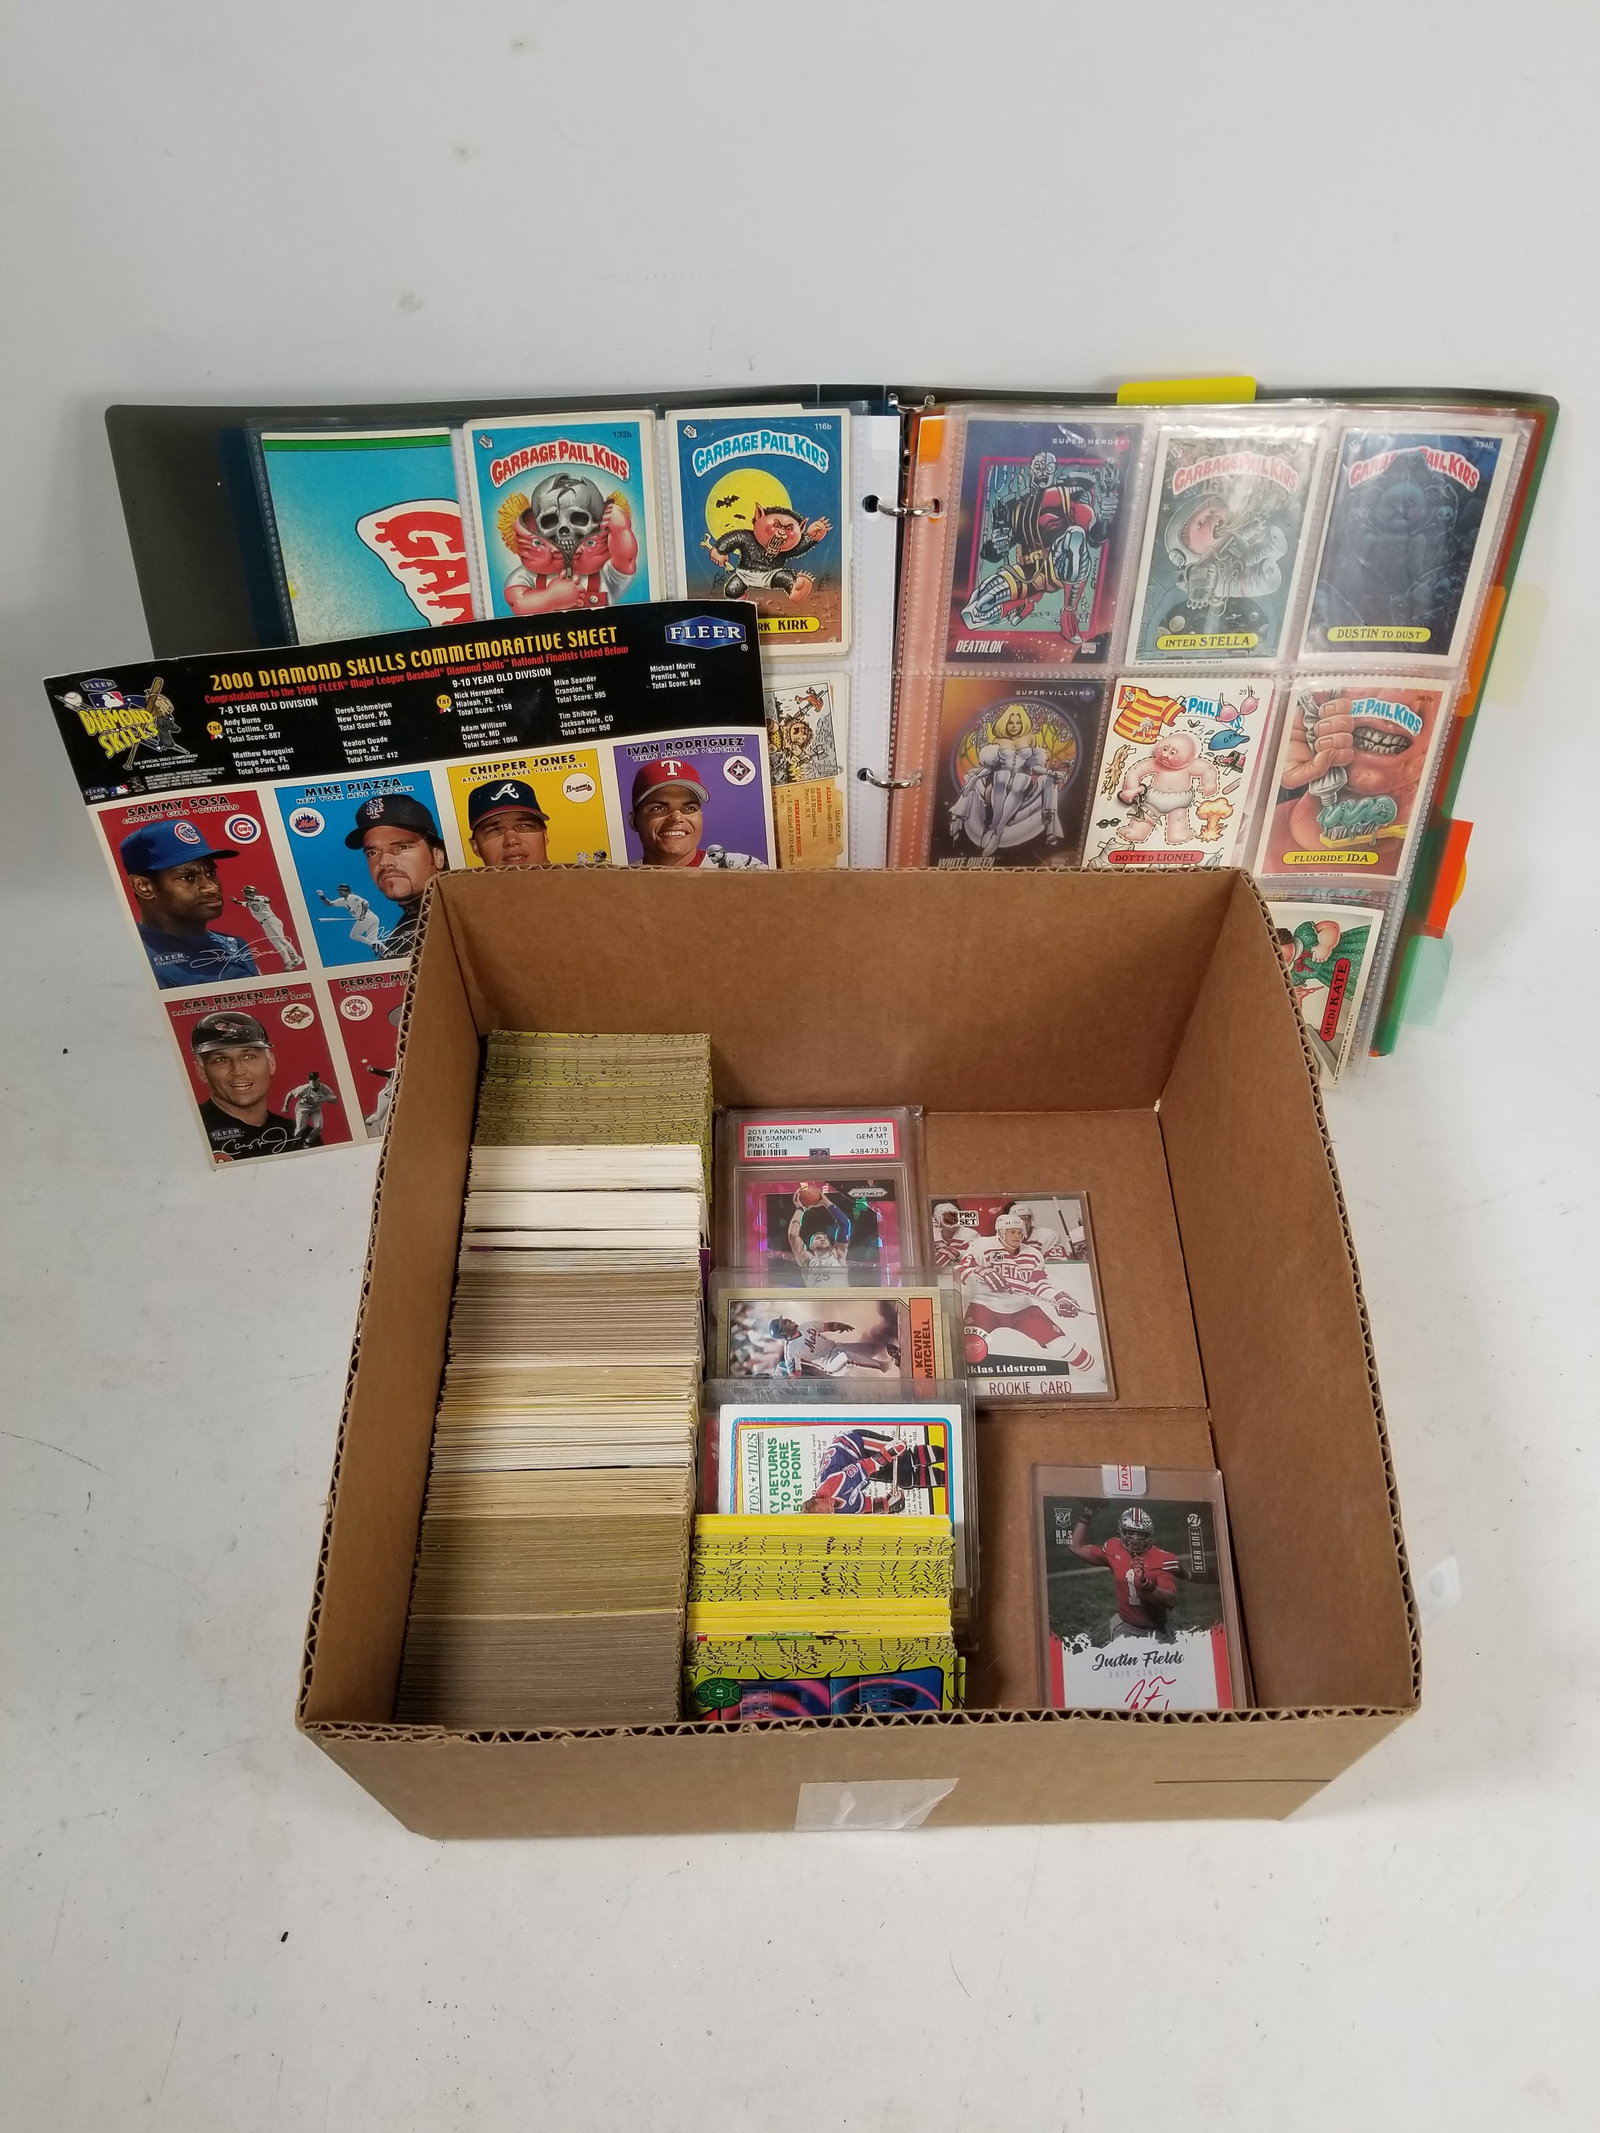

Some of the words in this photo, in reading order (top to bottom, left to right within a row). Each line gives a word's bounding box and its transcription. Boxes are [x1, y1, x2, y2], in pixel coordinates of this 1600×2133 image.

[694, 433, 758, 474] GARBAGE
[761, 432, 793, 453] PAIL
[794, 435, 828, 471] KIDS
[491, 445, 556, 485] GARBAGE
[559, 441, 593, 462] PAIL
[594, 445, 628, 479] KIDS
[1448, 454, 1478, 488] KIDS
[1174, 457, 1237, 491] GARBAGE
[1270, 461, 1298, 489] KIDS
[670, 626, 742, 639] FLEER
[778, 620, 808, 630] KIRK
[1165, 639, 1196, 647] INTER
[1199, 637, 1249, 646] STELLA
[1338, 629, 1379, 638] DUSTIN
[1396, 631, 1421, 639] DUST
[956, 641, 1003, 653] DEATHLOK
[210, 671, 254, 691] 2000
[259, 663, 341, 686] DIAMOND
[346, 653, 406, 677] SKILLS
[410, 633, 563, 665] COMMEMORATIVE
[568, 627, 617, 648] SHEET
[205, 692, 269, 704] Congratulations
[281, 689, 294, 697] the
[298, 685, 317, 695] 1999
[351, 677, 374, 689] Major
[376, 673, 405, 686] League
[447, 663, 481, 675] Diamond
[512, 655, 544, 667] National
[546, 651, 578, 663] Finalists
[580, 650, 602, 659] Listed
[605, 646, 628, 656] Below
[650, 664, 675, 672] Michael
[453, 680, 471, 688] 9-10
[472, 677, 494, 686] YEAR
[497, 673, 514, 682] OLD
[516, 668, 552, 679] DIVISION
[471, 688, 504, 697] Hernandez
[556, 695, 572, 704] Total
[219, 706, 233, 715] 7-8
[235, 704, 258, 713] YEAR
[261, 702, 277, 710] OLD
[280, 698, 318, 709] DIVISION
[335, 707, 354, 715] Derek
[458, 708, 473, 716] Total
[1188, 698, 1215, 717] PAIL
[80, 710, 154, 735] DIAMOND
[224, 719, 240, 727] Andy
[560, 720, 585, 728] Jackson
[1365, 699, 1393, 719] PAIL
[1394, 707, 1422, 733] KIDS
[339, 724, 355, 732] Total
[561, 728, 577, 736] Total
[99, 724, 159, 758] SKILLS
[228, 735, 245, 743] Total
[627, 744, 659, 756] IVAN
[666, 738, 745, 750] RODRIGUEZ
[236, 760, 259, 768] Orange
[347, 756, 363, 764] Total
[470, 761, 527, 775] CHIPPER
[533, 755, 576, 767] JONES
[661, 760, 682, 776] T
[238, 767, 254, 775] Total
[462, 774, 498, 782] ATLANTA
[501, 770, 531, 778] BRAVES
[305, 785, 341, 797] MIKE
[347, 778, 402, 792] PIAZZA
[127, 800, 183, 817] SAMMY
[190, 796, 229, 807] SOSA
[938, 857, 966, 868] WHITE
[967, 857, 995, 868] QUEEN
[1156, 853, 1196, 861] LIONEL
[1346, 854, 1368, 862] IDA
[153, 952, 184, 962] FLEER
[341, 976, 383, 987] PEDRO
[1330, 963, 1348, 1007] KATE
[183, 1001, 208, 1009] CAL
[214, 991, 268, 1004] RIPKEN,
[275, 989, 293, 997] JR.
[1324, 1008, 1337, 1036] MEDI
[923, 1318, 932, 1379] MITCHELL
[997, 1363, 1047, 1373] Lidstrom
[989, 1382, 1031, 1394] ROOKIE
[1040, 1381, 1071, 1394] CARD
[747, 1433, 758, 1475] TIMES
[791, 1440, 801, 1479] POINT
[768, 1437, 779, 1496] RETURNS
[780, 1442, 790, 1487] SCORE
[781, 1492, 791, 1510] TO
[1055, 1512, 1070, 1522] RC
[1056, 1530, 1072, 1538] RPS
[1193, 1531, 1201, 1547] ONE
[1194, 1550, 1203, 1571] YEAR
[1125, 1569, 1142, 1605] 1
[1092, 1654, 1138, 1670] Justin
[1143, 1650, 1184, 1668] Fields
[1109, 1670, 1130, 1678] OHIO
